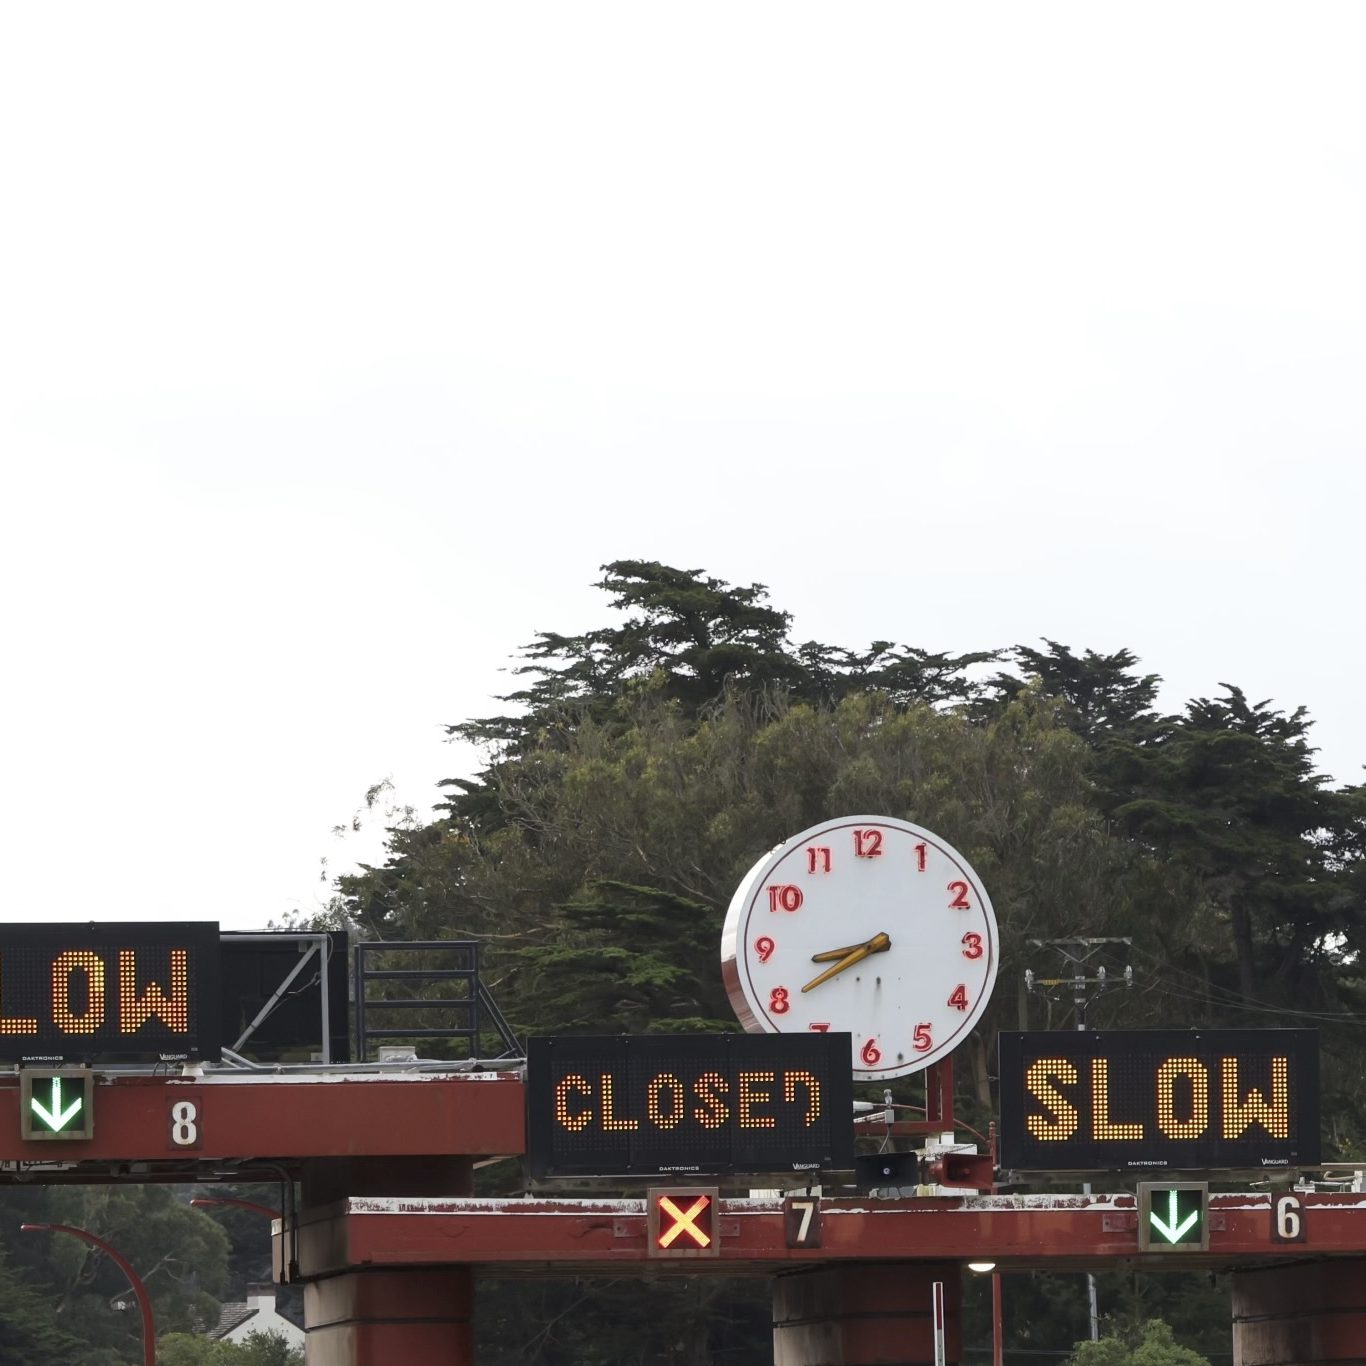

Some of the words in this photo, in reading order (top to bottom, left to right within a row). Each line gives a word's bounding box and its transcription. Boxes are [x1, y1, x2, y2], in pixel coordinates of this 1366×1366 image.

[853, 830, 883, 857] 12
[915, 842, 927, 871] 1
[807, 847, 832, 874] 11
[767, 885, 803, 912] 10
[947, 881, 970, 910] 2
[754, 936, 775, 963] 9
[962, 932, 984, 959] 3
[768, 986, 790, 1015] 8
[947, 984, 968, 1011] 4
[912, 1022, 933, 1052] 5
[859, 1038, 882, 1066] 6
[1026, 1056, 1289, 1141] SLOW
[172, 1101, 197, 1145] 8
[791, 1202, 815, 1242] 7
[1277, 1196, 1300, 1239] 6
